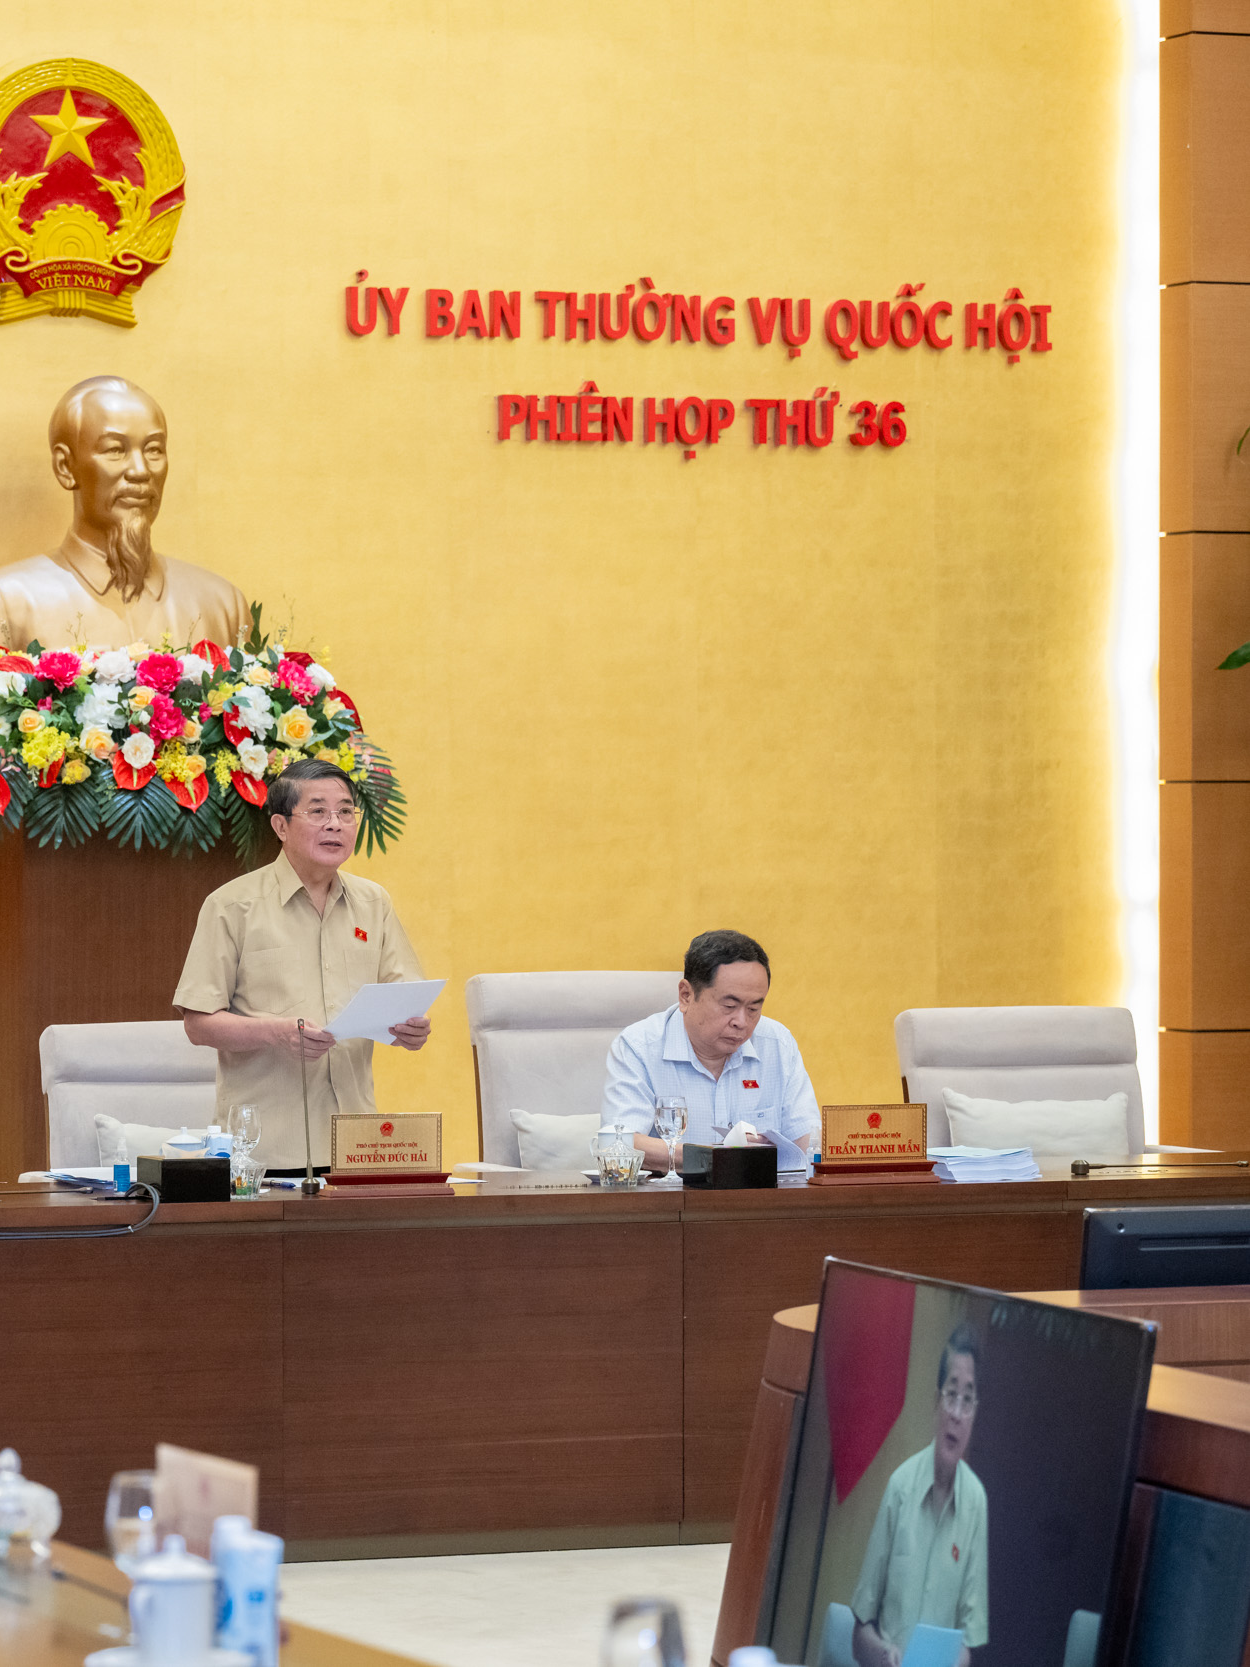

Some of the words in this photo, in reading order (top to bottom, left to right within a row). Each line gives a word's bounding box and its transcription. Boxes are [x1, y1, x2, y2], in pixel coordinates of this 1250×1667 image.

[36, 273, 71, 290] VIỆT
[74, 274, 112, 291] NAM
[345, 268, 410, 337] ỦY
[425, 288, 521, 339] BAN
[534, 276, 736, 347] THƯỜNG
[751, 297, 811, 358] VỤ
[825, 282, 953, 361] QUỐC
[965, 286, 1053, 364] HỘI
[497, 380, 634, 443] PHIÊN
[644, 395, 735, 460] HỌP
[746, 386, 841, 448] THỨ
[849, 400, 907, 447] 36
[859, 1144, 895, 1154] THANH
[897, 1139, 920, 1153] MẪN
[346, 1150, 386, 1164] NGUYỄN
[388, 1151, 408, 1162] ĐỨC
[410, 1150, 428, 1162] HẢI
